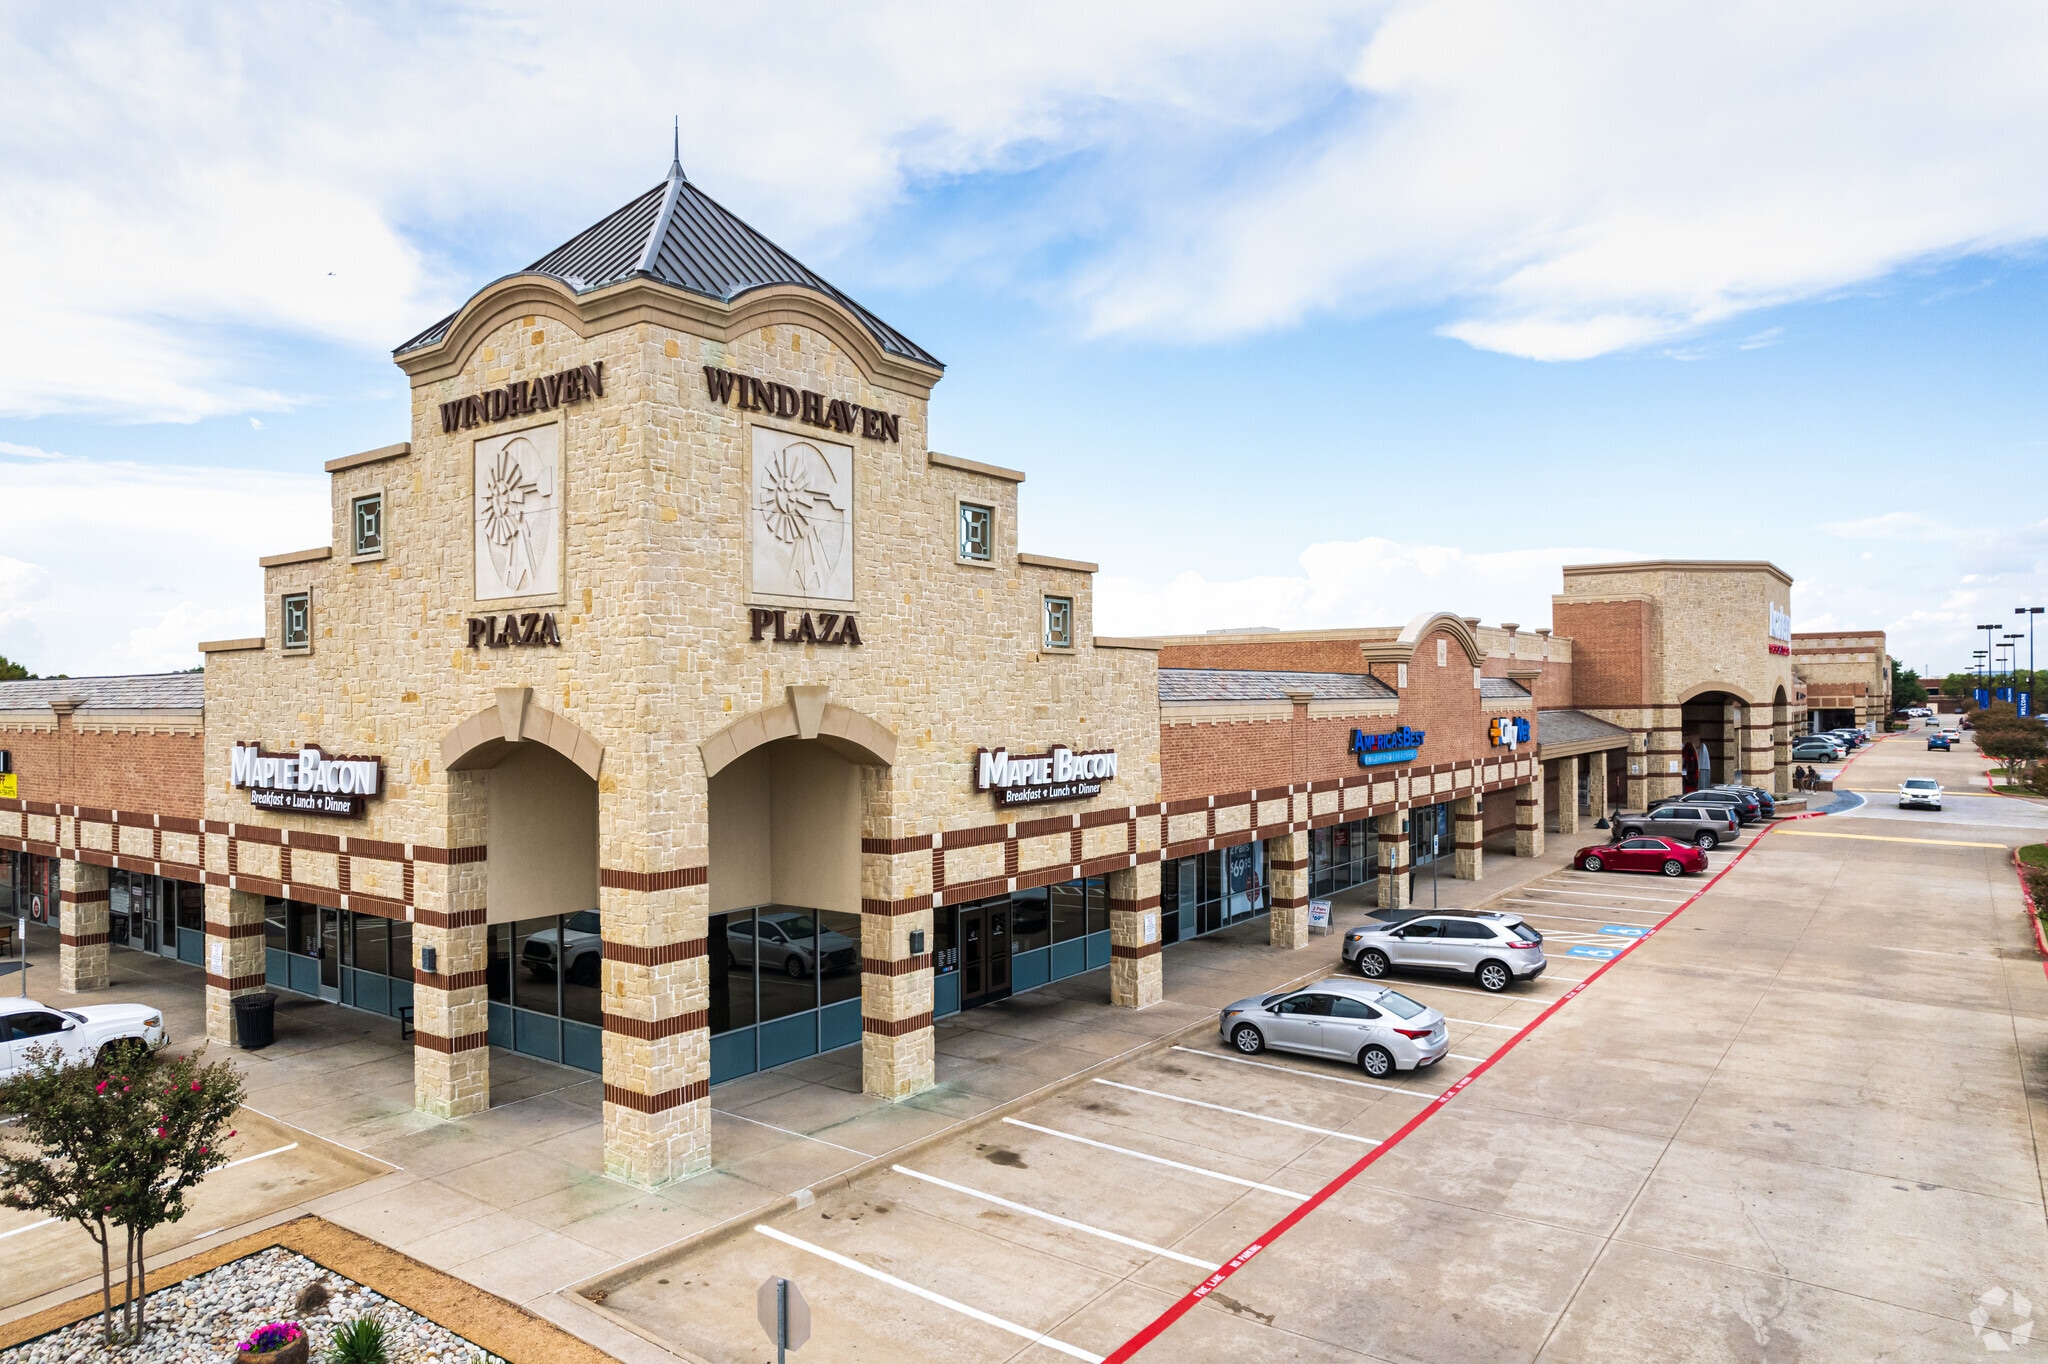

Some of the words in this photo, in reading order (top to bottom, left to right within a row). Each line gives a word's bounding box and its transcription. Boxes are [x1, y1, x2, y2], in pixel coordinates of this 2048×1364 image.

[439, 361, 603, 433] WINDHAVEN
[703, 366, 900, 443] WINDHAVEN
[467, 612, 561, 648] PLAZA
[750, 608, 863, 645] PLAZA
[1403, 726, 1425, 747] BEST
[231, 746, 299, 789] MAPLE
[298, 749, 377, 795] BACON
[979, 751, 1053, 789] MAPLE
[1053, 748, 1118, 782] BACON
[251, 790, 284, 806] Breakfast
[292, 794, 315, 809] Lunch
[324, 797, 351, 812] Dinner
[1006, 789, 1041, 803] Breakfast
[1050, 785, 1070, 798] Lunch
[1079, 783, 1100, 795] Dinner
[1193, 1285, 1211, 1298] FIRE
[1206, 1273, 1226, 1287] LANE
[1229, 1260, 1241, 1268] NO
[1237, 1244, 1262, 1261] PARKING
